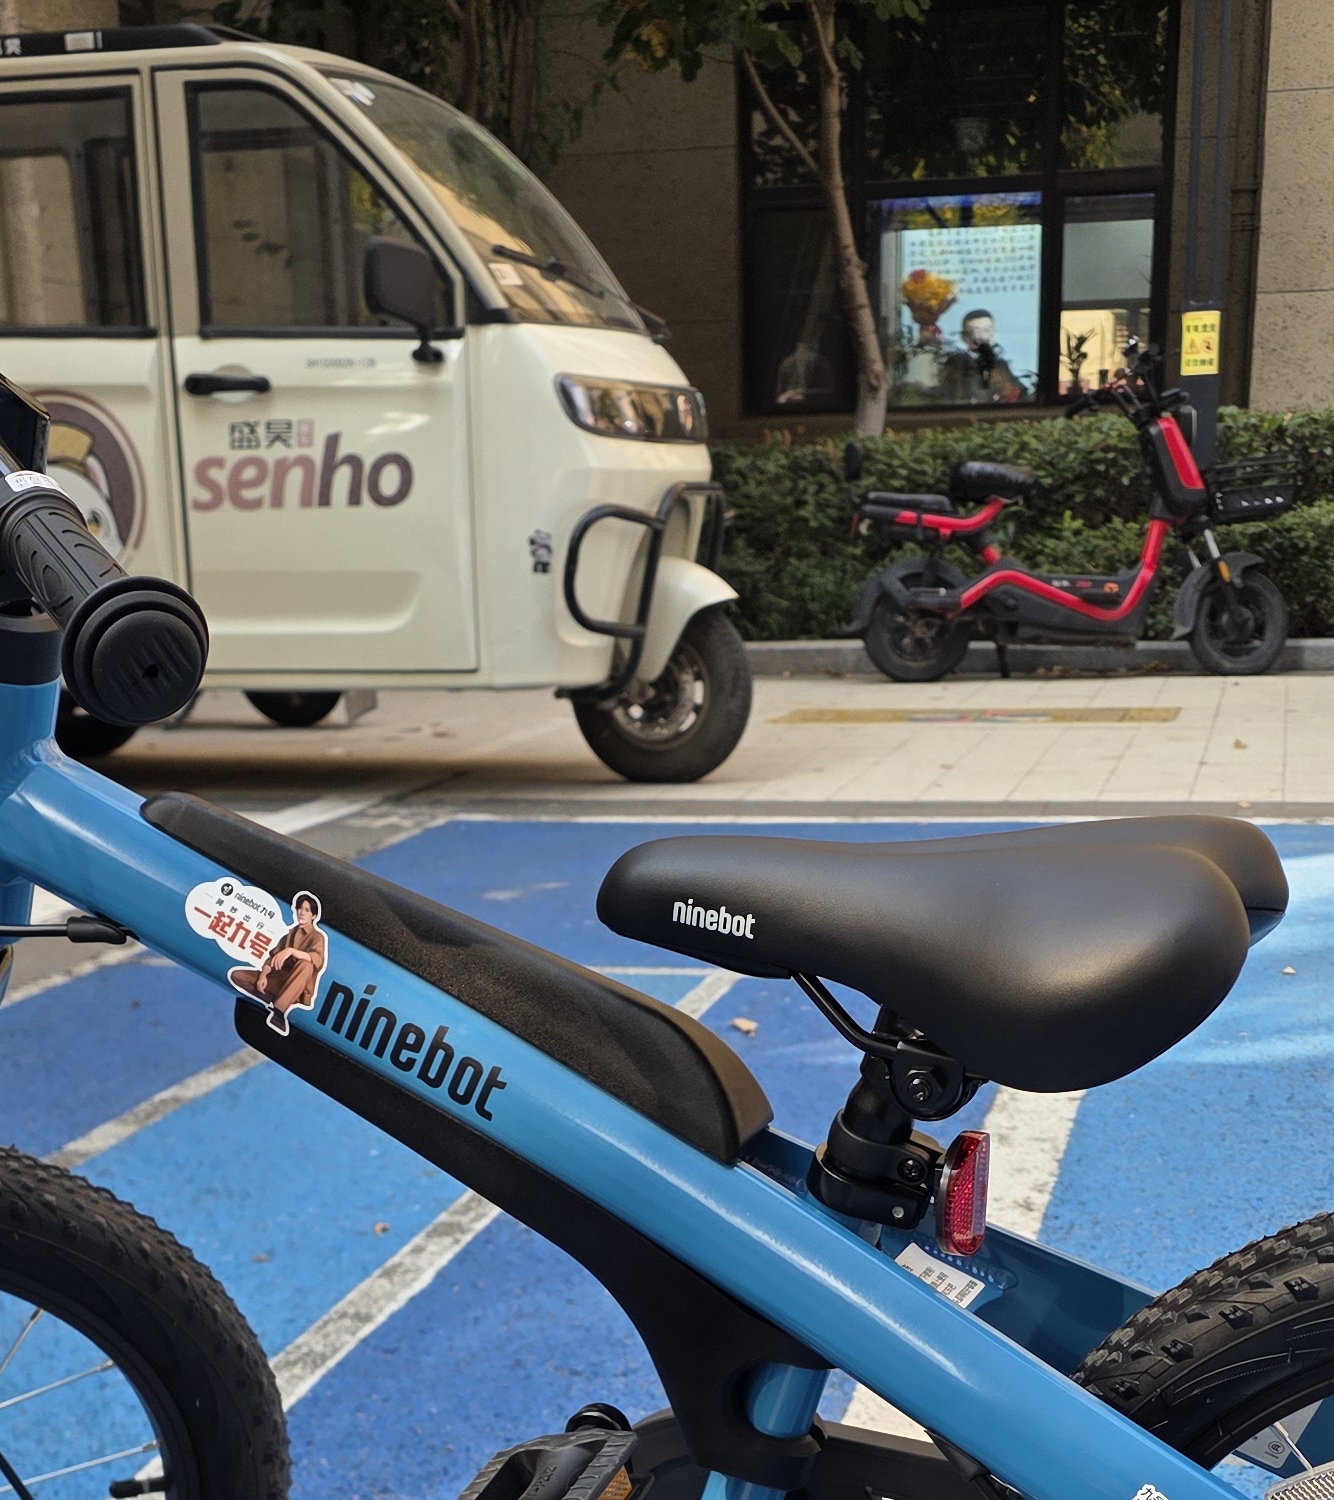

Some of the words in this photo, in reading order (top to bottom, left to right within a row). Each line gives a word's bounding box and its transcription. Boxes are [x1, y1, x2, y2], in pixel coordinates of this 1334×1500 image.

[191, 431, 414, 512] senho
[194, 906, 273, 960] 一起九号
[672, 898, 756, 940] ninebot
[316, 980, 508, 1122] ninebot
